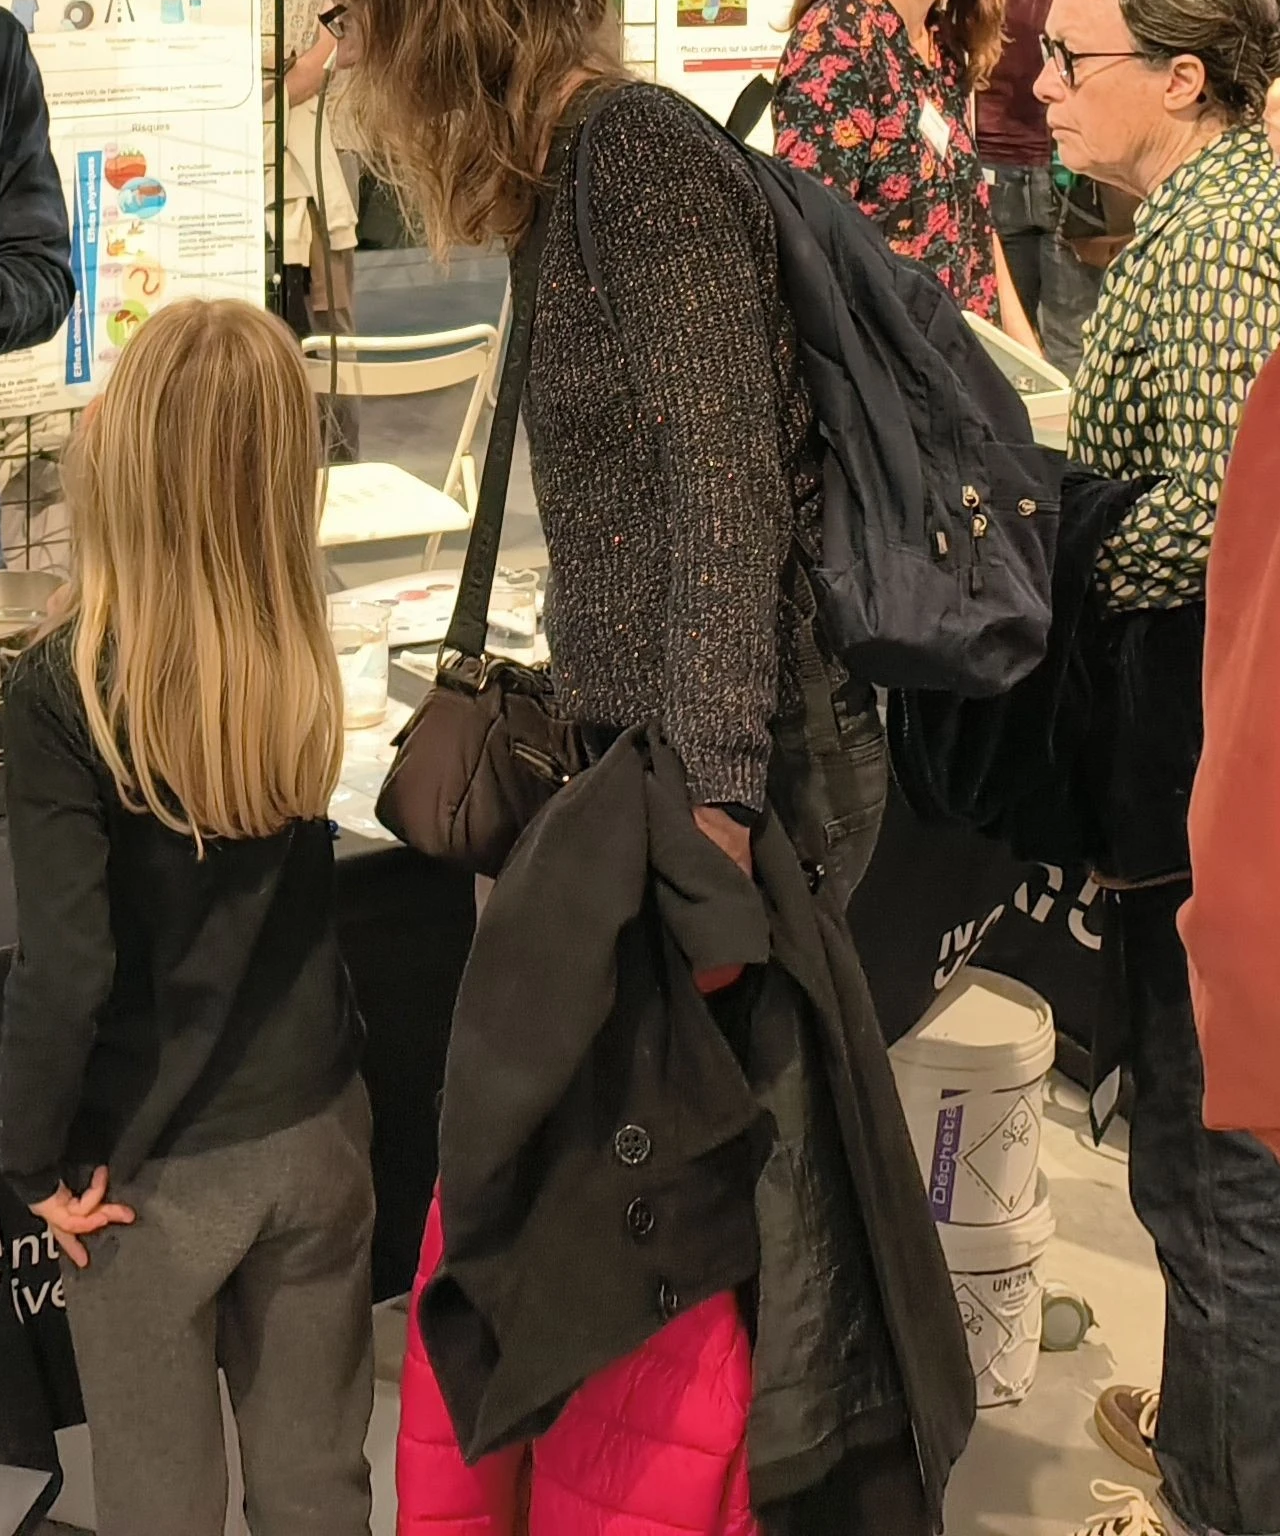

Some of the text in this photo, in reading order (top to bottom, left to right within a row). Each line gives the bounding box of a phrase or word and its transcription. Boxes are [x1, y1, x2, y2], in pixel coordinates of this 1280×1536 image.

[132, 123, 170, 134] Risques
[932, 1107, 957, 1205] Déchets
[993, 1278, 1011, 1292] UN
